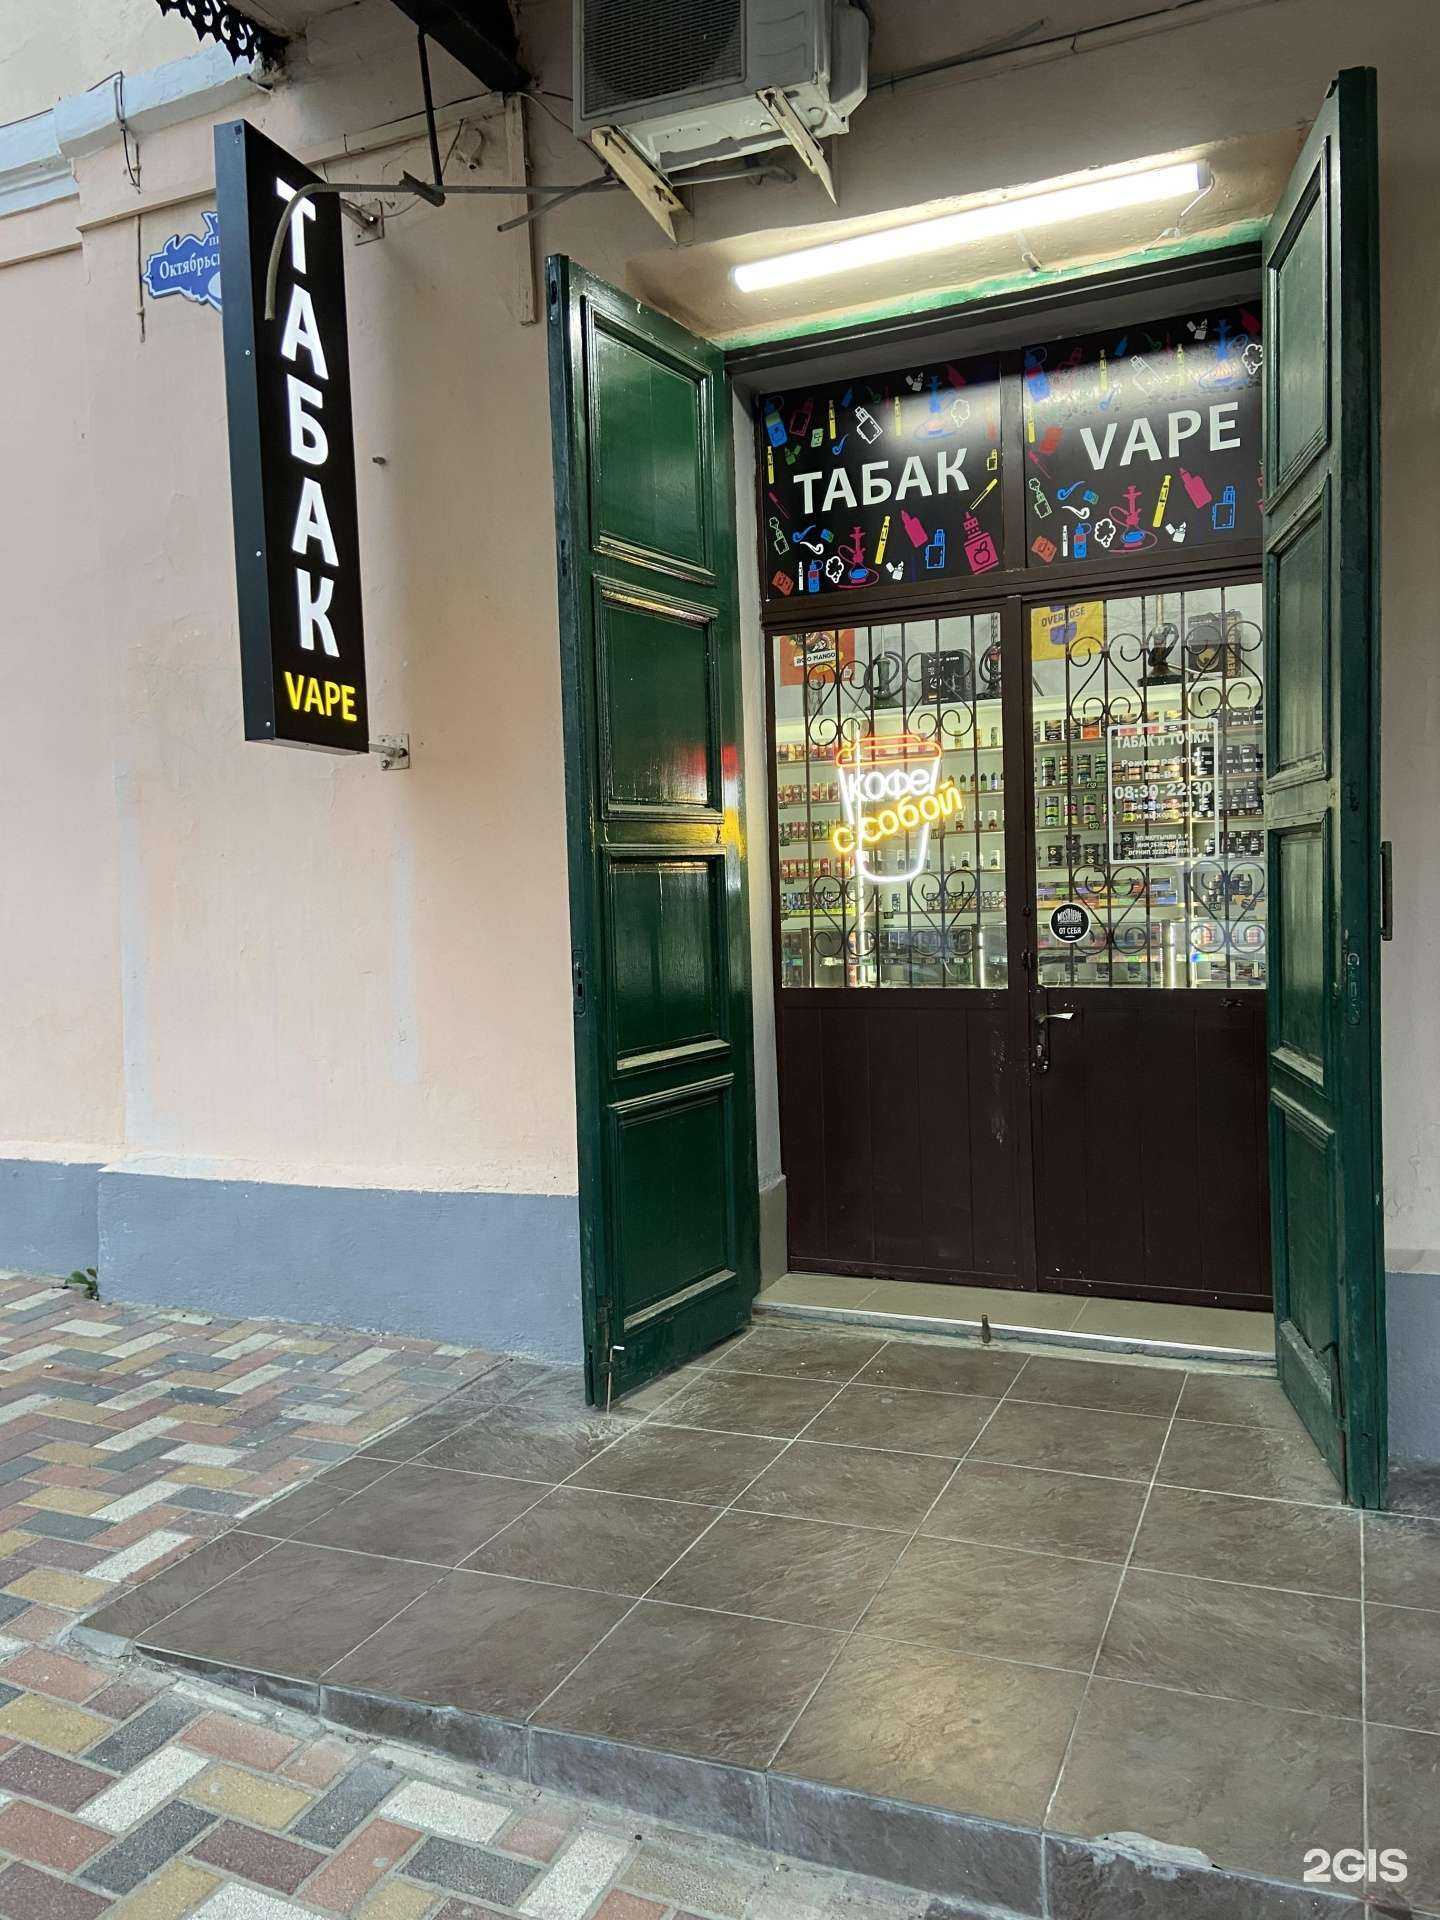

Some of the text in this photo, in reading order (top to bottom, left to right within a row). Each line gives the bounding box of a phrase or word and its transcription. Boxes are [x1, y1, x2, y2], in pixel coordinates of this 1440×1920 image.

[159, 253, 220, 279] Октябрьс
[276, 176, 339, 657] ТАБАК
[1080, 401, 1242, 471] VAPE
[793, 448, 969, 514] ТАБАК
[1041, 606, 1086, 627] OVEROSE
[813, 652, 836, 662] MANGO
[283, 671, 358, 722] VAPE
[1115, 734, 1154, 748] ТАБАК
[1114, 781, 1212, 799] 08:30-22:30
[860, 780, 963, 842] собой
[1059, 927, 1082, 935] ОТ СЕБЯ
